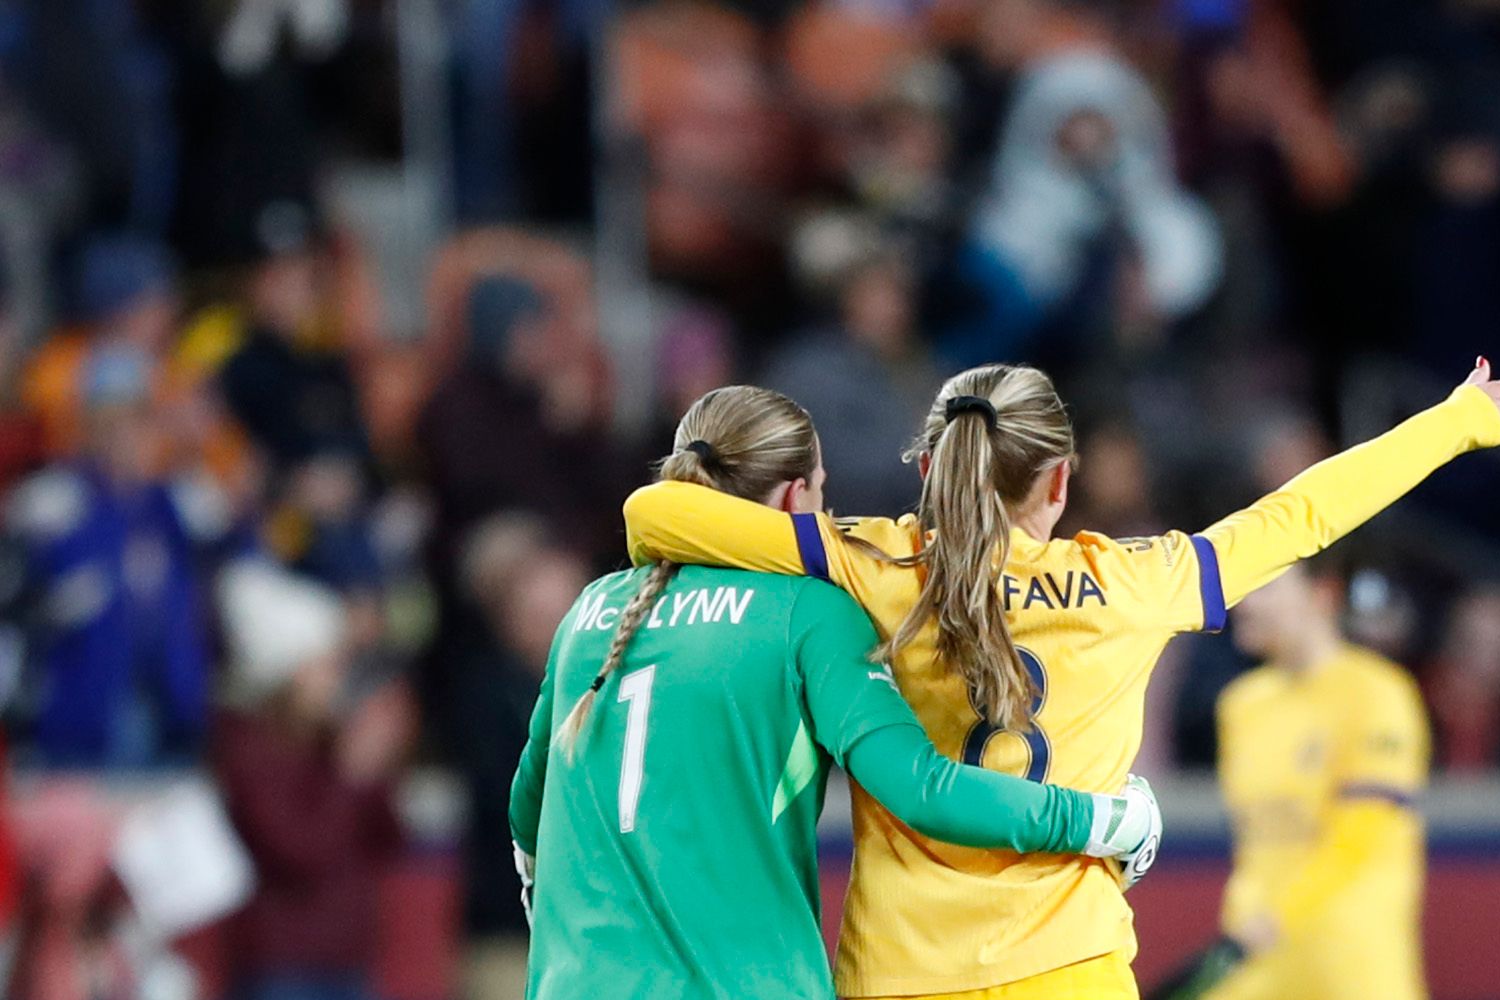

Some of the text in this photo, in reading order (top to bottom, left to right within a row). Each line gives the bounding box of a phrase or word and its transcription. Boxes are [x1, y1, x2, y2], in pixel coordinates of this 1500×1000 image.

[571, 586, 755, 634] McLYNN
[1002, 570, 1107, 611] FAVA
[617, 664, 655, 833] 1
[961, 644, 1052, 785] 8
